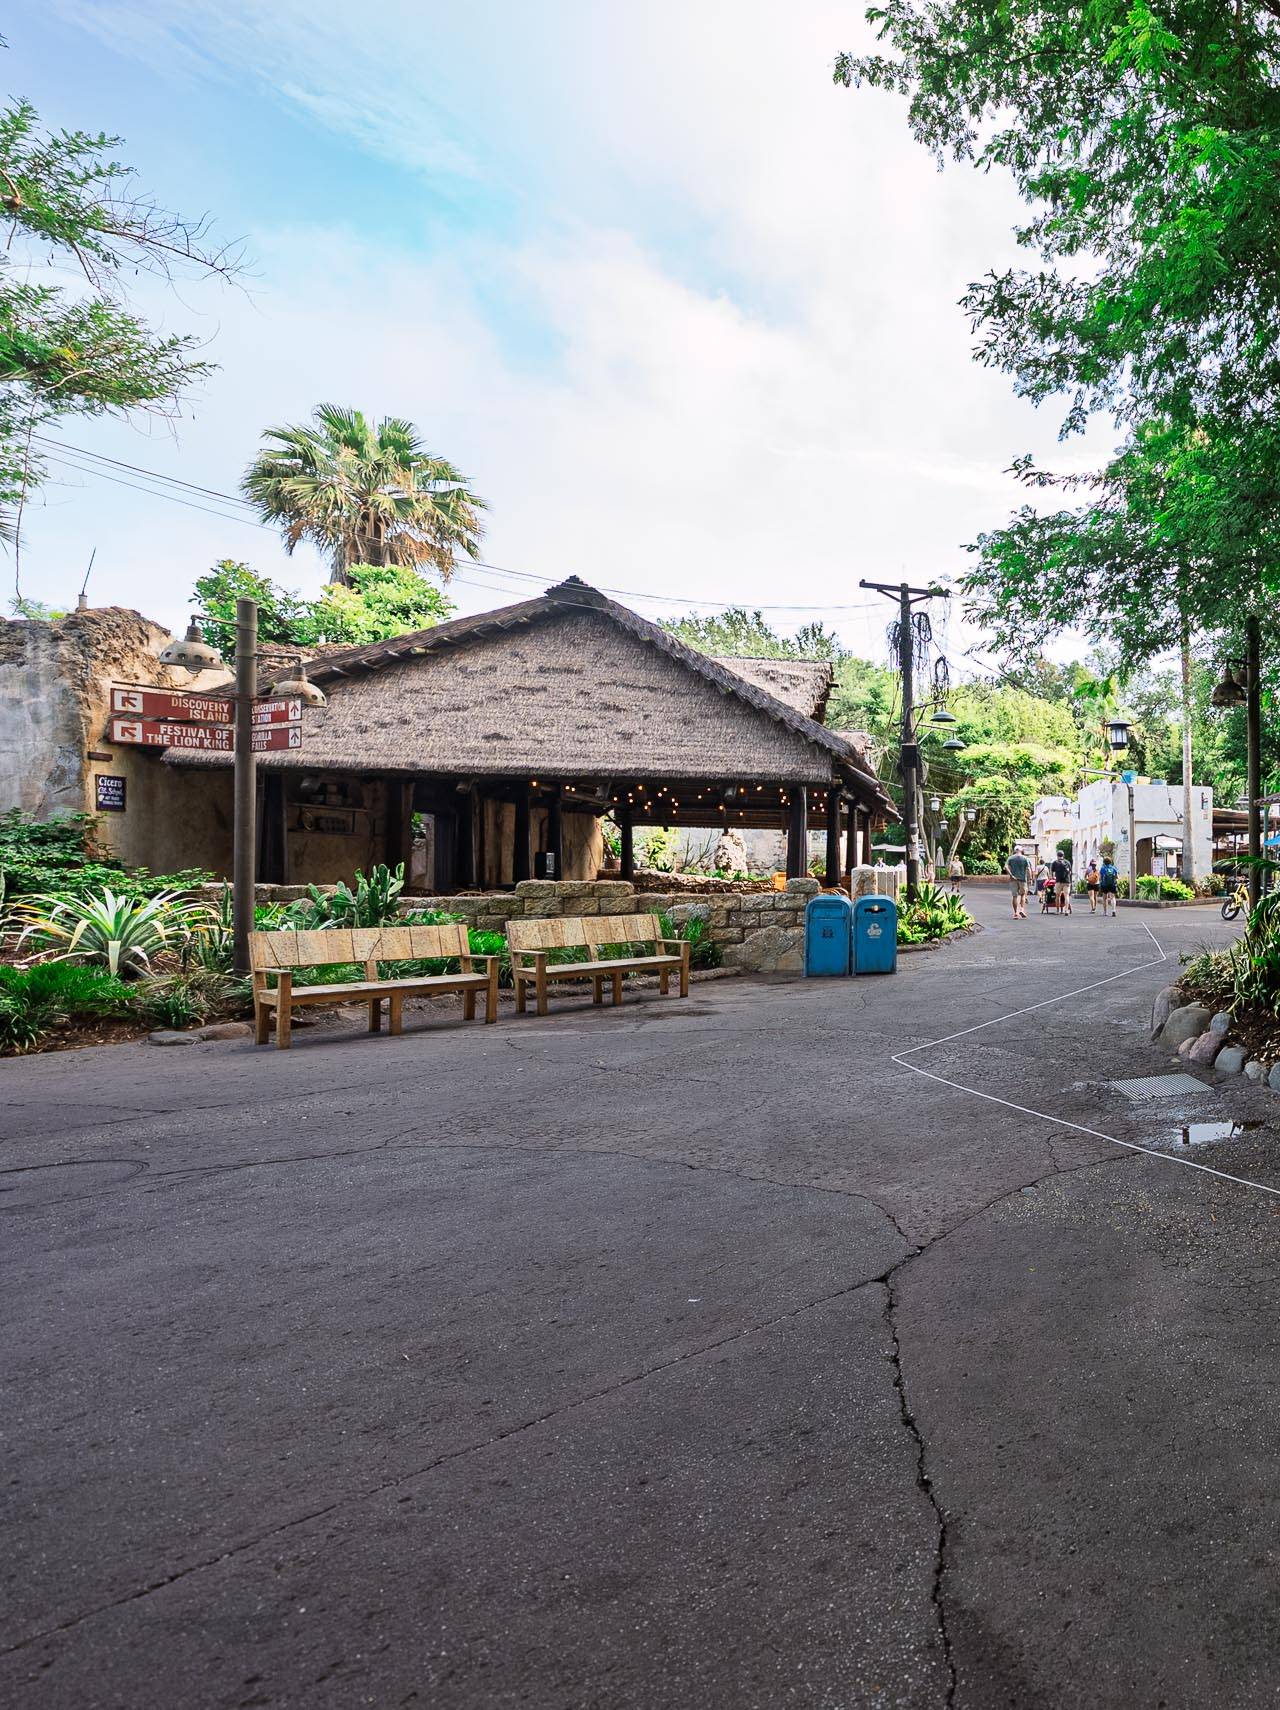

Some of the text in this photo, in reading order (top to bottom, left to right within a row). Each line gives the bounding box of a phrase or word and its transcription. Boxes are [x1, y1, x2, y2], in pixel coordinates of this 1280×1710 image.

[171, 697, 229, 712] DISCOVERY
[189, 709, 229, 722] ISLAND
[160, 724, 229, 740] FESTIVAL OF
[146, 733, 229, 750] THE LION KING
[251, 741, 267, 751] FALLS
